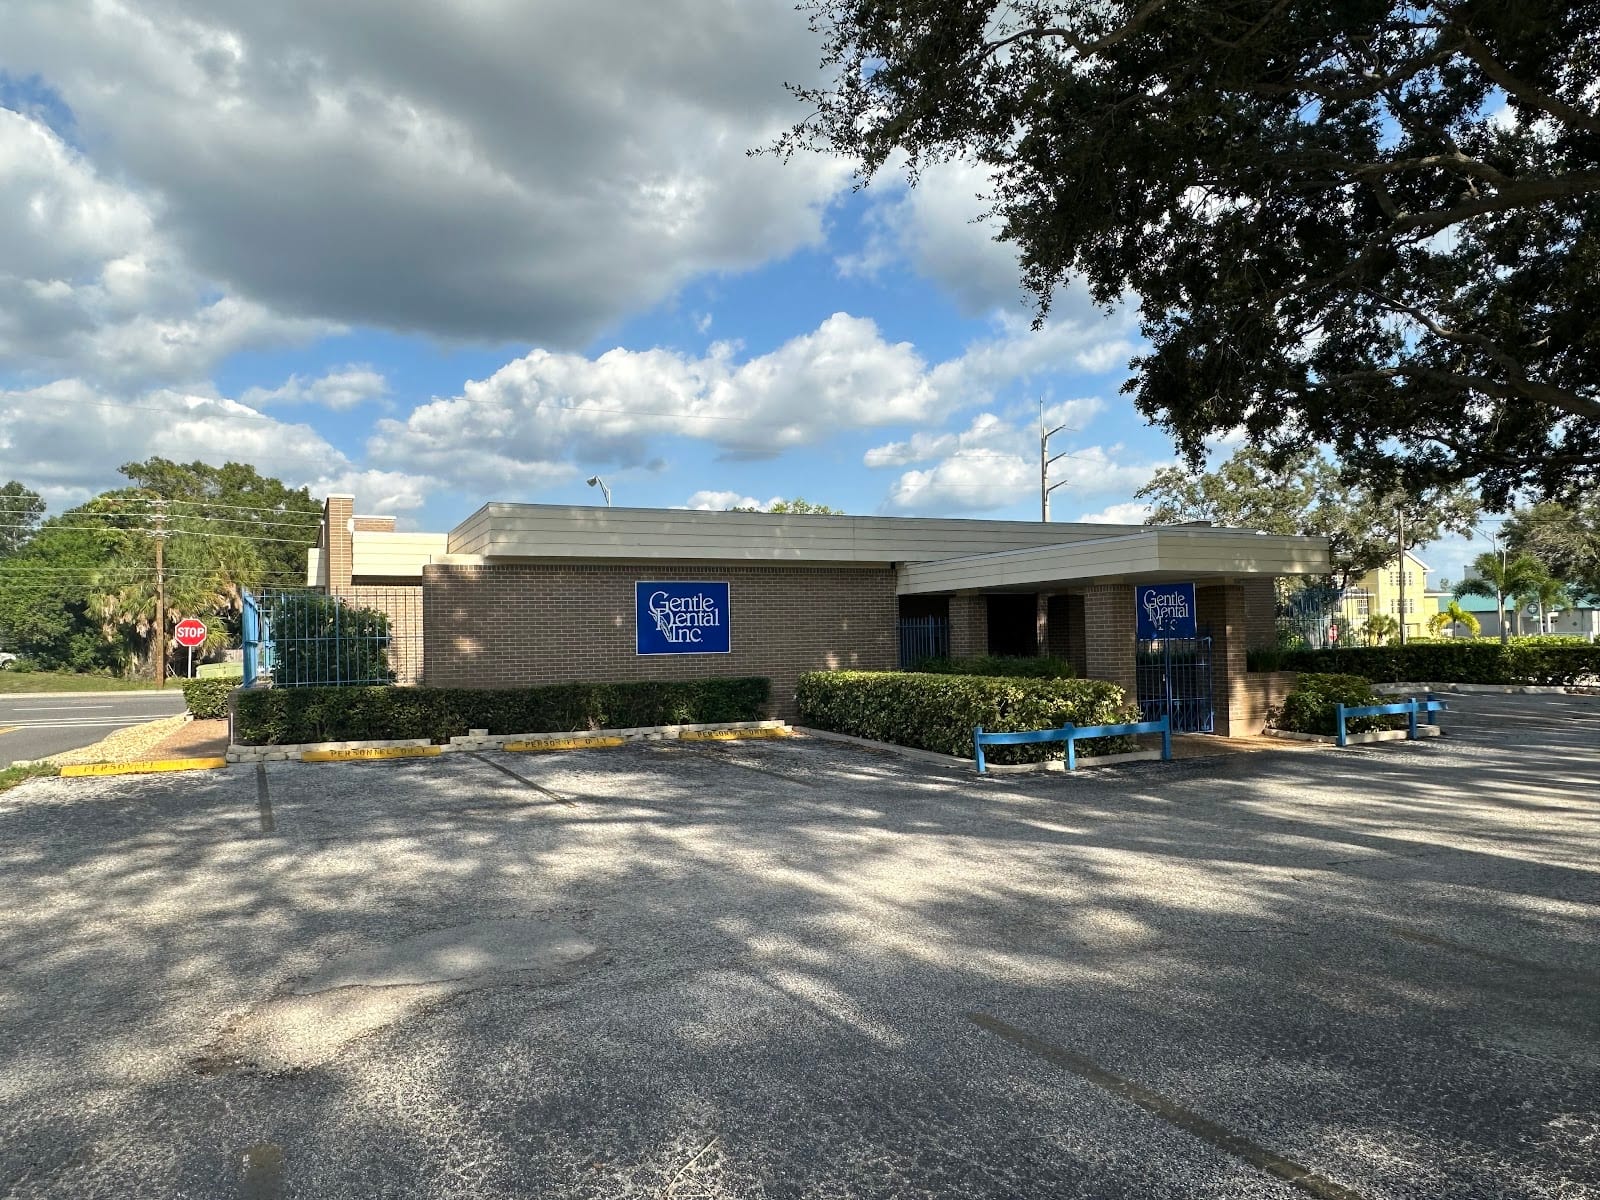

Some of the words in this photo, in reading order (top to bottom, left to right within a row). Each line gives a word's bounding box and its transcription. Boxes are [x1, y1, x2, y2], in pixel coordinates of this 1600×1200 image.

[649, 591, 714, 614] Gentle
[1143, 589, 1186, 609] Gentle
[656, 607, 720, 630] Dental
[1148, 603, 1189, 621] Dental
[177, 627, 205, 638] STOP
